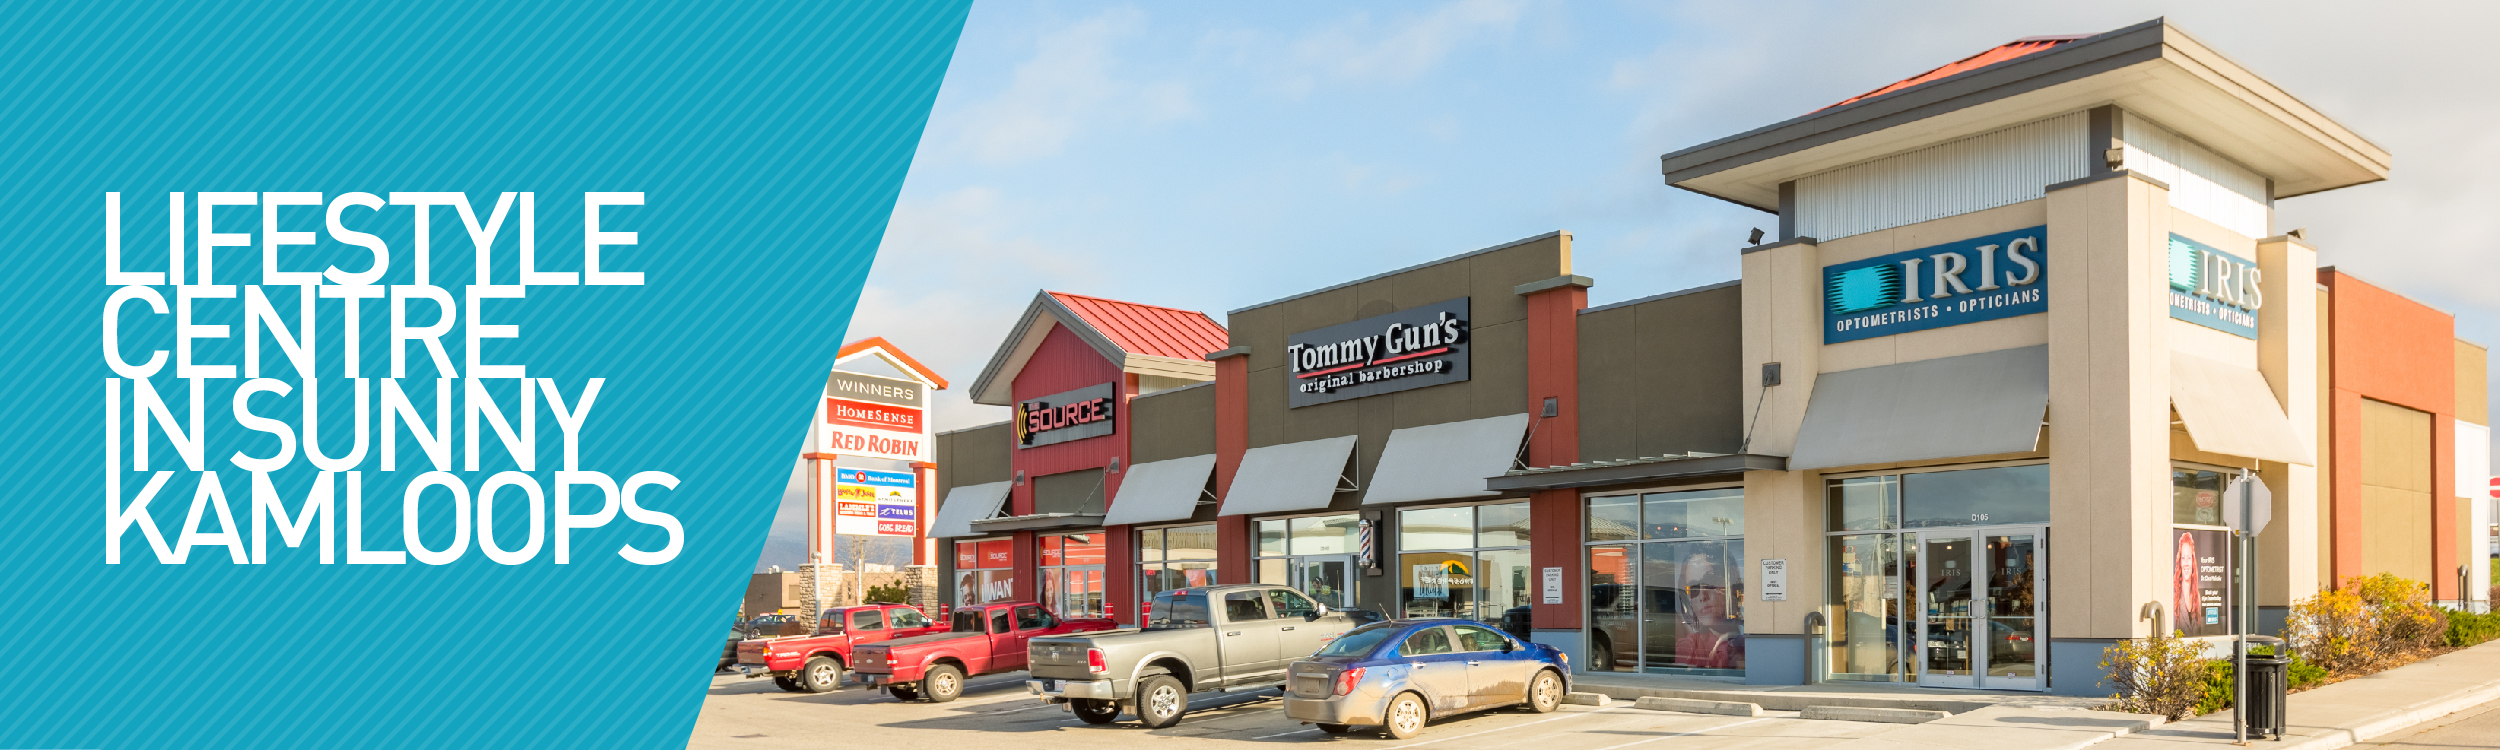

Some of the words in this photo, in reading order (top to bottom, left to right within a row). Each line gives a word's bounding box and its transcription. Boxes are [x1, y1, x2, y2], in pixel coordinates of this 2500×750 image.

[1900, 235, 2040, 303] IRIS
[2196, 249, 2262, 310] IRIS
[1836, 305, 1939, 332] OPTOMETRISTS
[1959, 288, 2040, 313] OPTICIANS
[1288, 334, 1379, 373] Tommy
[1385, 311, 1459, 354] Gun's
[837, 378, 914, 400] WINNERS
[1300, 372, 1354, 393] original
[1359, 359, 1443, 383] barbershop
[1028, 397, 1104, 433] SOURCE
[831, 430, 865, 451] RED
[867, 434, 919, 456] ROBIN
[891, 508, 914, 516] TELUS
[1971, 513, 1989, 522] D105
[1941, 569, 1961, 577] IRIS
